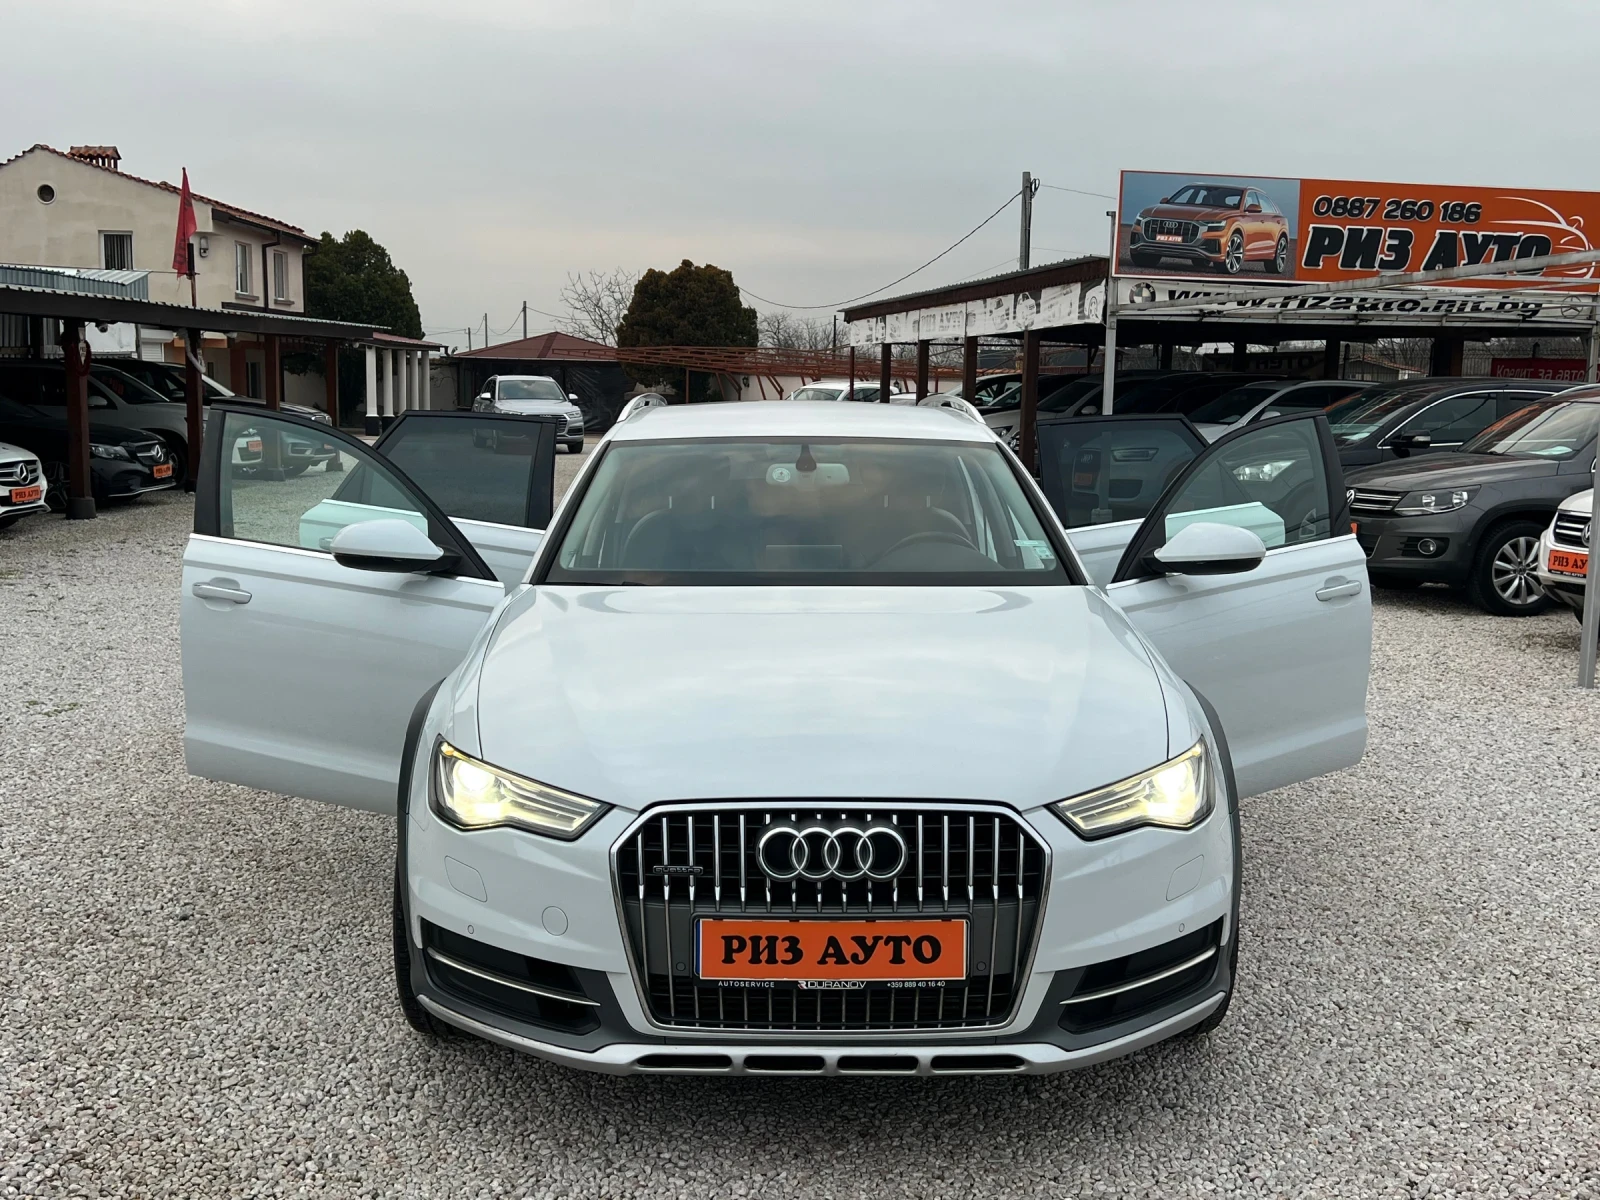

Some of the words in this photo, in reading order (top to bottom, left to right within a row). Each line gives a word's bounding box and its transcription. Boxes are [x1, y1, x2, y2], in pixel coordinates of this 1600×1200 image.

[1314, 195, 1380, 217] 0887
[1383, 198, 1434, 221] 260
[1440, 201, 1482, 223] 186
[1303, 224, 1414, 271] РИЗ
[1421, 230, 1552, 276] АУТО
[1496, 364, 1534, 379] Кредит
[1538, 368, 1553, 380] за
[1552, 555, 1569, 567] РИЗ
[1571, 558, 1588, 570] АУ
[720, 935, 804, 965] РИЗ
[816, 935, 942, 965] АУТО
[718, 980, 775, 988] AUTOSERVICE
